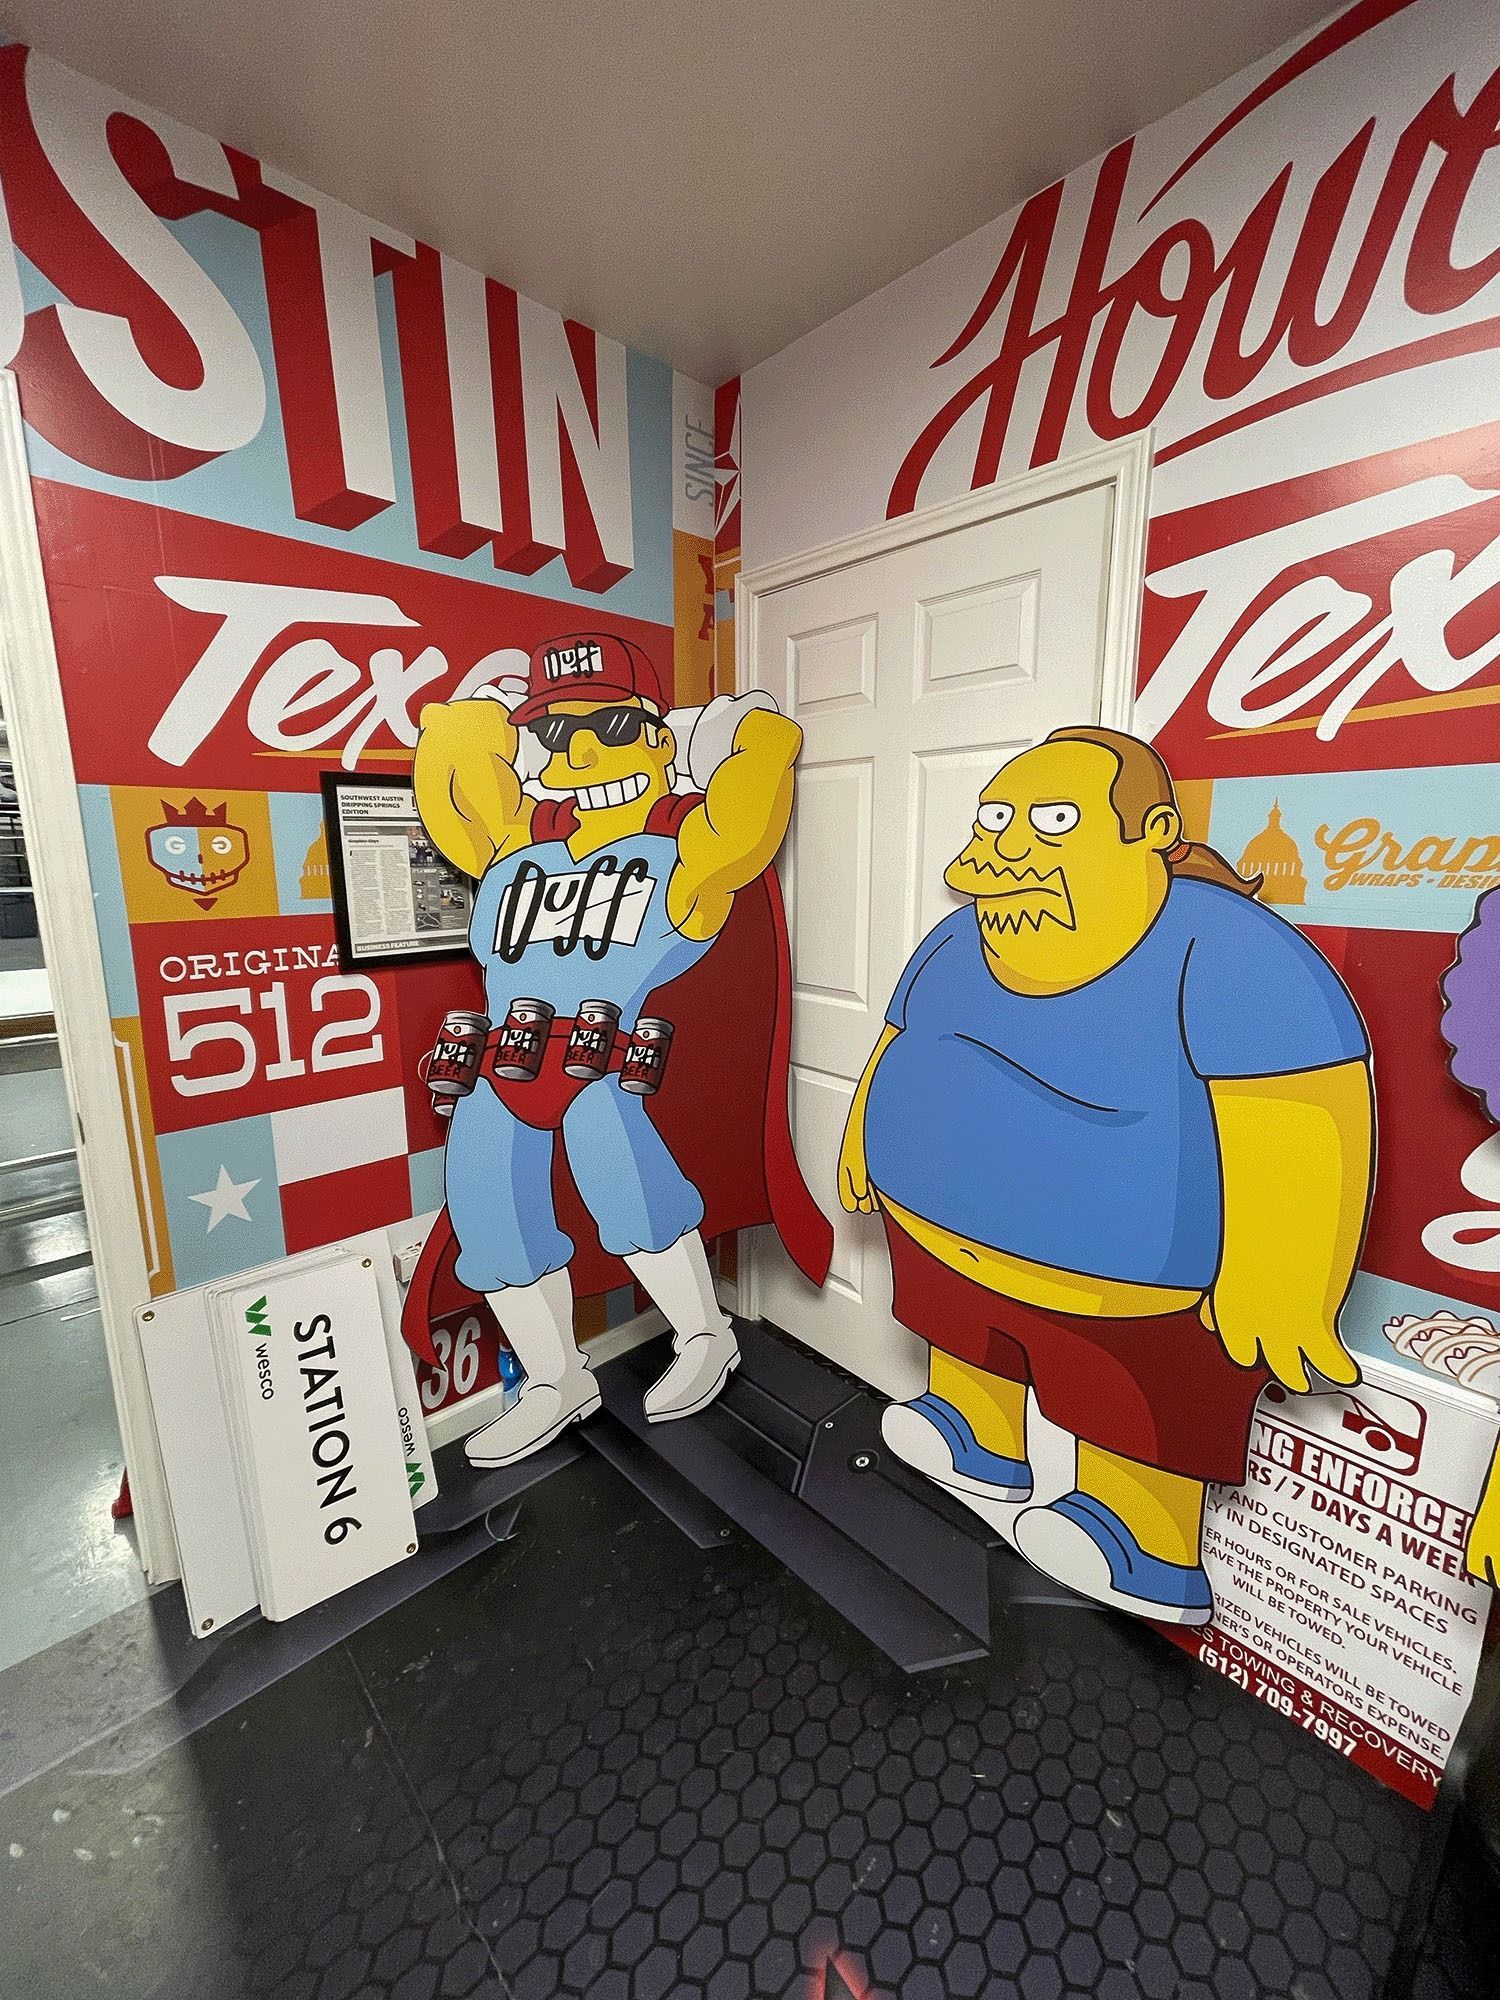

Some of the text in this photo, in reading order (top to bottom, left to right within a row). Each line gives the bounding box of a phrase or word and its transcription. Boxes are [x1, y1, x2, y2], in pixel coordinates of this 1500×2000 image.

[0, 45, 634, 594] STIN
[498, 855, 652, 965] Duff
[1349, 872, 1424, 888] WRAPS
[356, 940, 420, 952] BUSINESS FEATURE
[163, 973, 384, 1098] 512
[255, 1343, 275, 1401] wesco
[413, 1317, 481, 1409] 36
[293, 1313, 363, 1546] STATION 6
[398, 1407, 417, 1457] wesco
[1291, 1480, 1306, 1501] 7
[1310, 1490, 1371, 1534] DAYS
[1375, 1523, 1393, 1547] A
[1301, 1444, 1473, 1549] ENFORCE
[1204, 1525, 1457, 1674] ER HOURS OR FOR SALE VEHICLES.
[1226, 1508, 1244, 1527] IN
[1248, 1519, 1366, 1590] DESIGNATED
[1370, 1584, 1449, 1634] SPACES
[1229, 1490, 1478, 1625] AND CUSTOMER PARKING
[1232, 1574, 1346, 1650] WILL BE TOWED.
[1237, 1560, 1263, 1584] THE
[1265, 1577, 1342, 1627] PROPERTY
[1344, 1621, 1389, 1655] YOUR
[1392, 1647, 1463, 1697] VEHICLE
[1254, 1616, 1322, 1666] VEHICLES
[1325, 1658, 1361, 1690] WILL
[1365, 1683, 1386, 1705] BE
[1389, 1696, 1450, 1743] TOWED
[1199, 1643, 1358, 1757] (512) 709-7997
[1219, 1635, 1296, 1694] TOWING
[1300, 1689, 1314, 1709] &
[1320, 1700, 1442, 1787] RECOVERY
[1252, 1634, 1273, 1654] OR
[1276, 1651, 1364, 1710] OPERATORS
[1367, 1704, 1445, 1761] EXPENSE.
